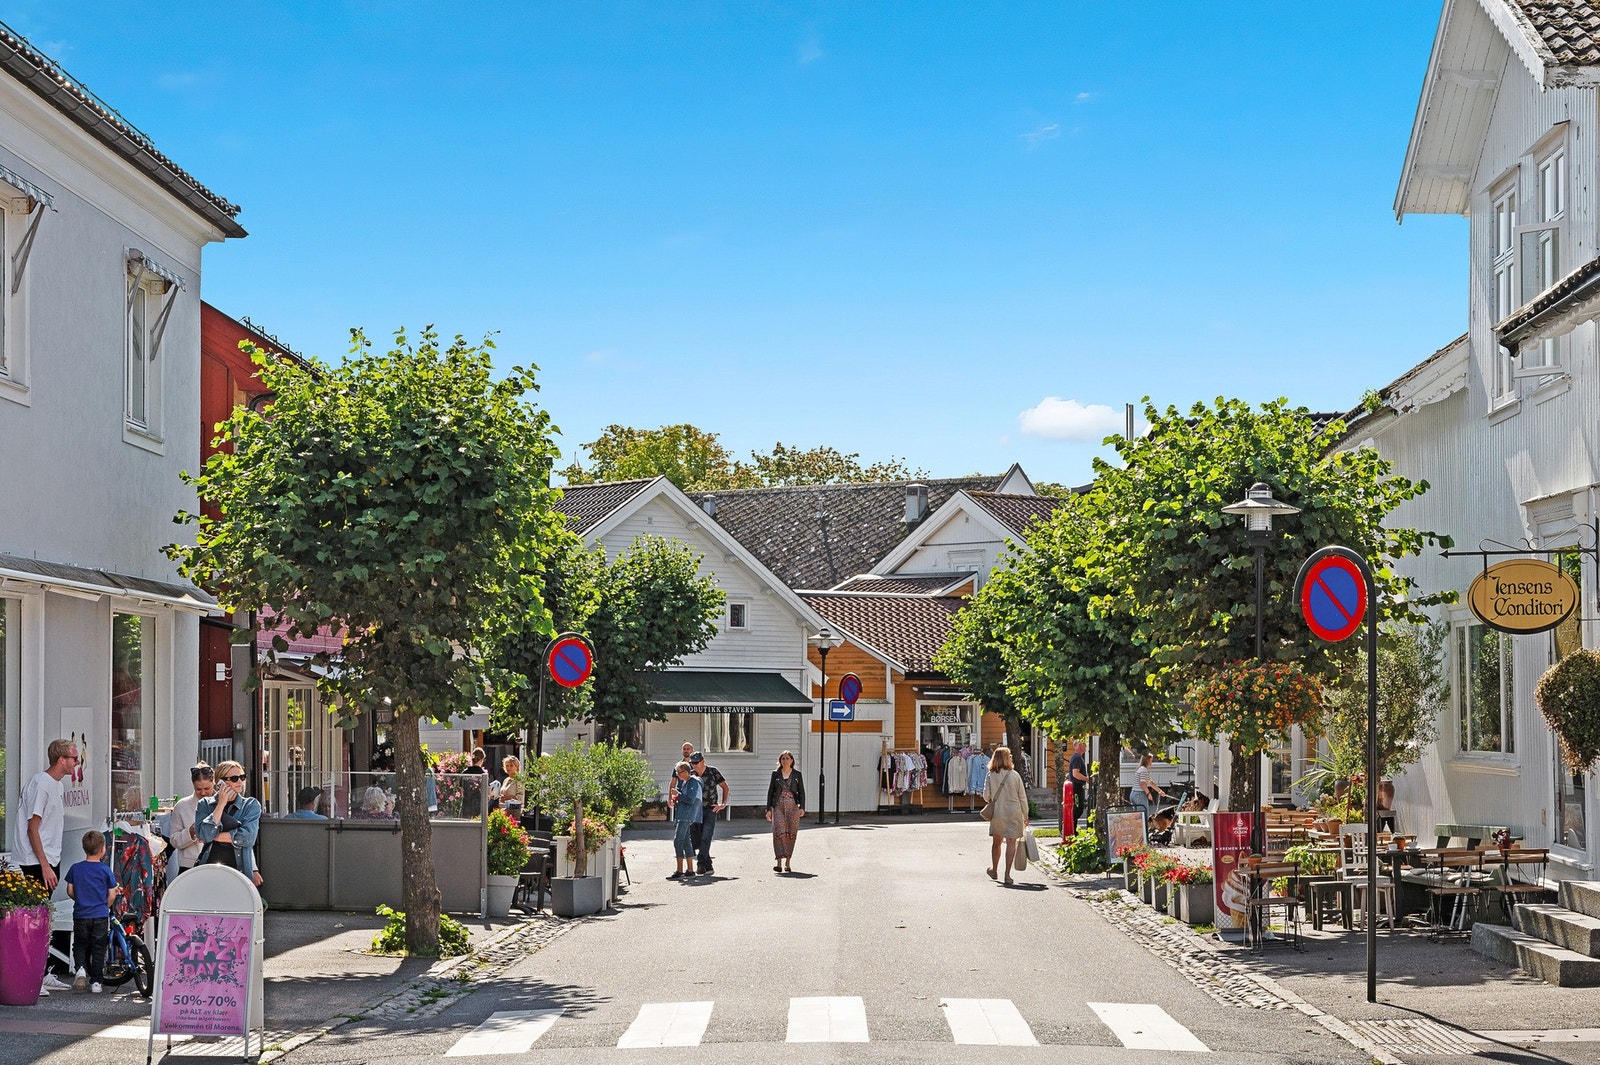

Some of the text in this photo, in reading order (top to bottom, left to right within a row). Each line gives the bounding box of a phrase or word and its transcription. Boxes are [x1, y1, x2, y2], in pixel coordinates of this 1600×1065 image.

[1489, 575, 1553, 600] Jensens
[1490, 597, 1564, 620] Conditori
[930, 715, 960, 723] BØRSEN
[63, 789, 90, 808] MORENA
[168, 934, 248, 960] CRAZY
[183, 961, 229, 976] DAYS
[173, 995, 237, 1007] 50%-70%
[164, 1022, 204, 1030] Velkommen
